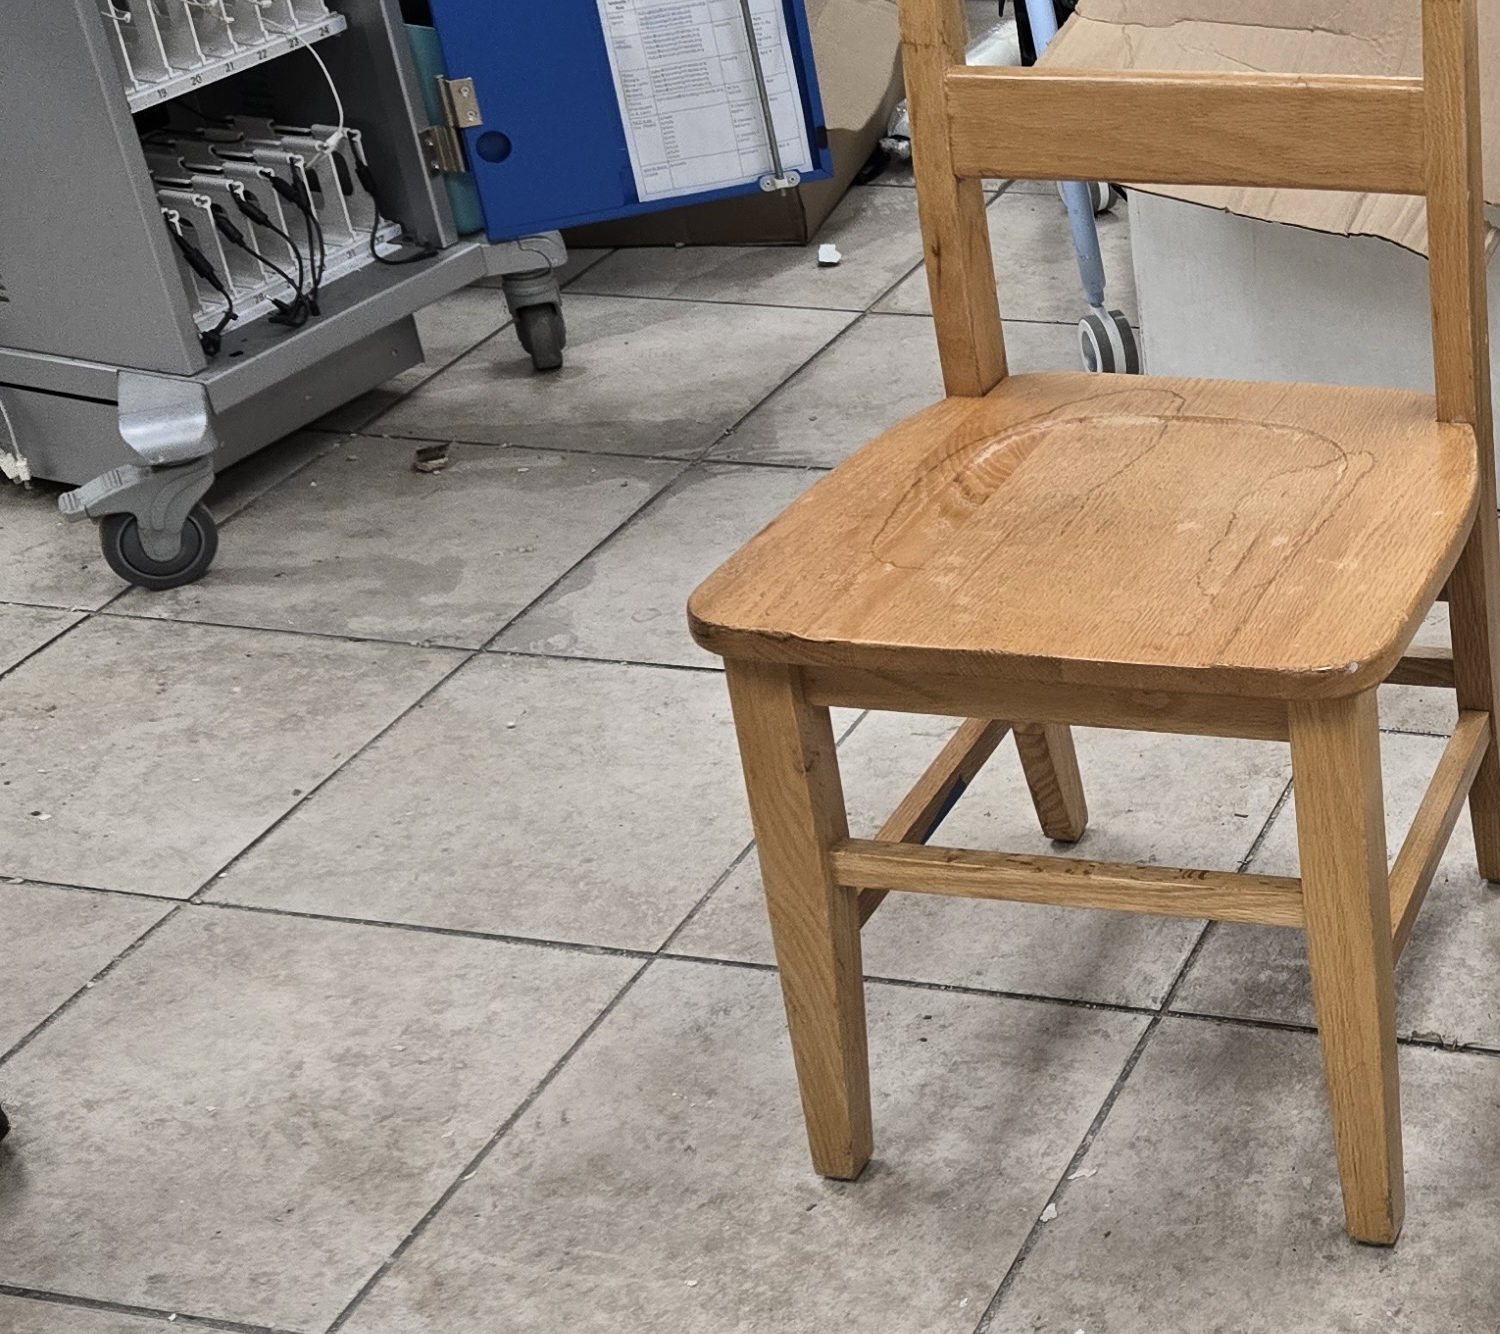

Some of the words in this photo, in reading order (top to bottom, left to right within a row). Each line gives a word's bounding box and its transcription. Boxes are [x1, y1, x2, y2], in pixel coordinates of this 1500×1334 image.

[189, 73, 203, 87] 20
[223, 60, 236, 73] 21
[256, 48, 269, 61] 22
[317, 25, 330, 37] 24
